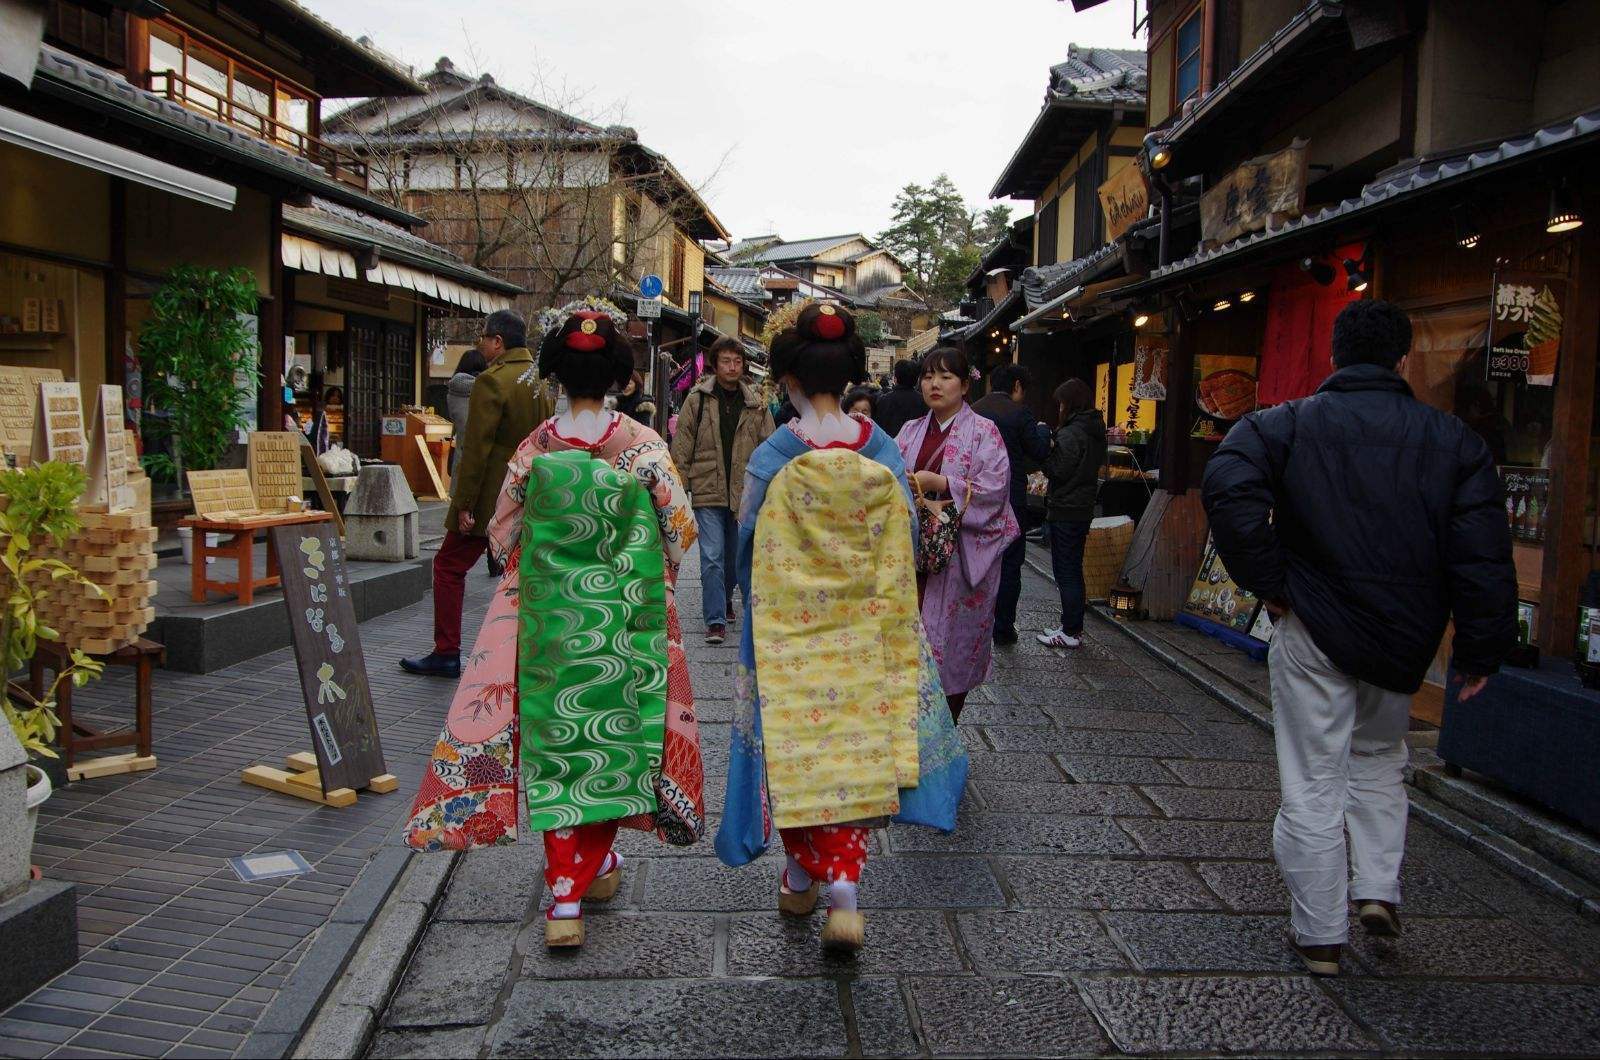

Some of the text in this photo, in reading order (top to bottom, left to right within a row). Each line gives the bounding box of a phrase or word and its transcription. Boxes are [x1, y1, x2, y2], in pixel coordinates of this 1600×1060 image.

[1496, 284, 1536, 307] 抹茶
[1496, 305, 1536, 322] ソフト
[1492, 355, 1530, 371] ¥380
